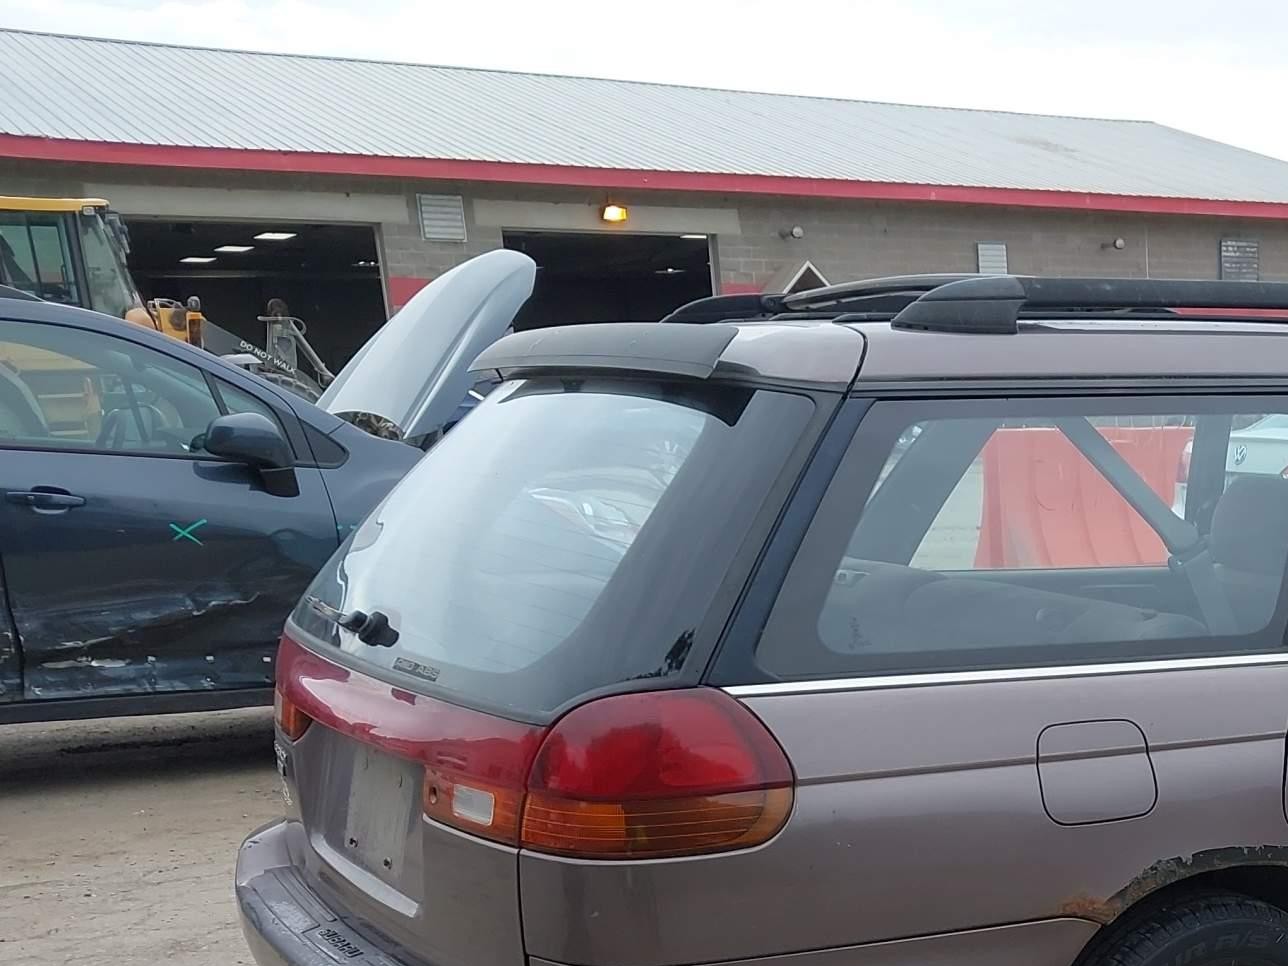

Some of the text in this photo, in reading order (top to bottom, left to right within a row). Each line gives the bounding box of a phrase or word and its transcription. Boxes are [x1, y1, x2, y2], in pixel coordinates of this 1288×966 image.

[240, 340, 297, 375] DO NOT WALK
[318, 928, 364, 959] SUBARU
